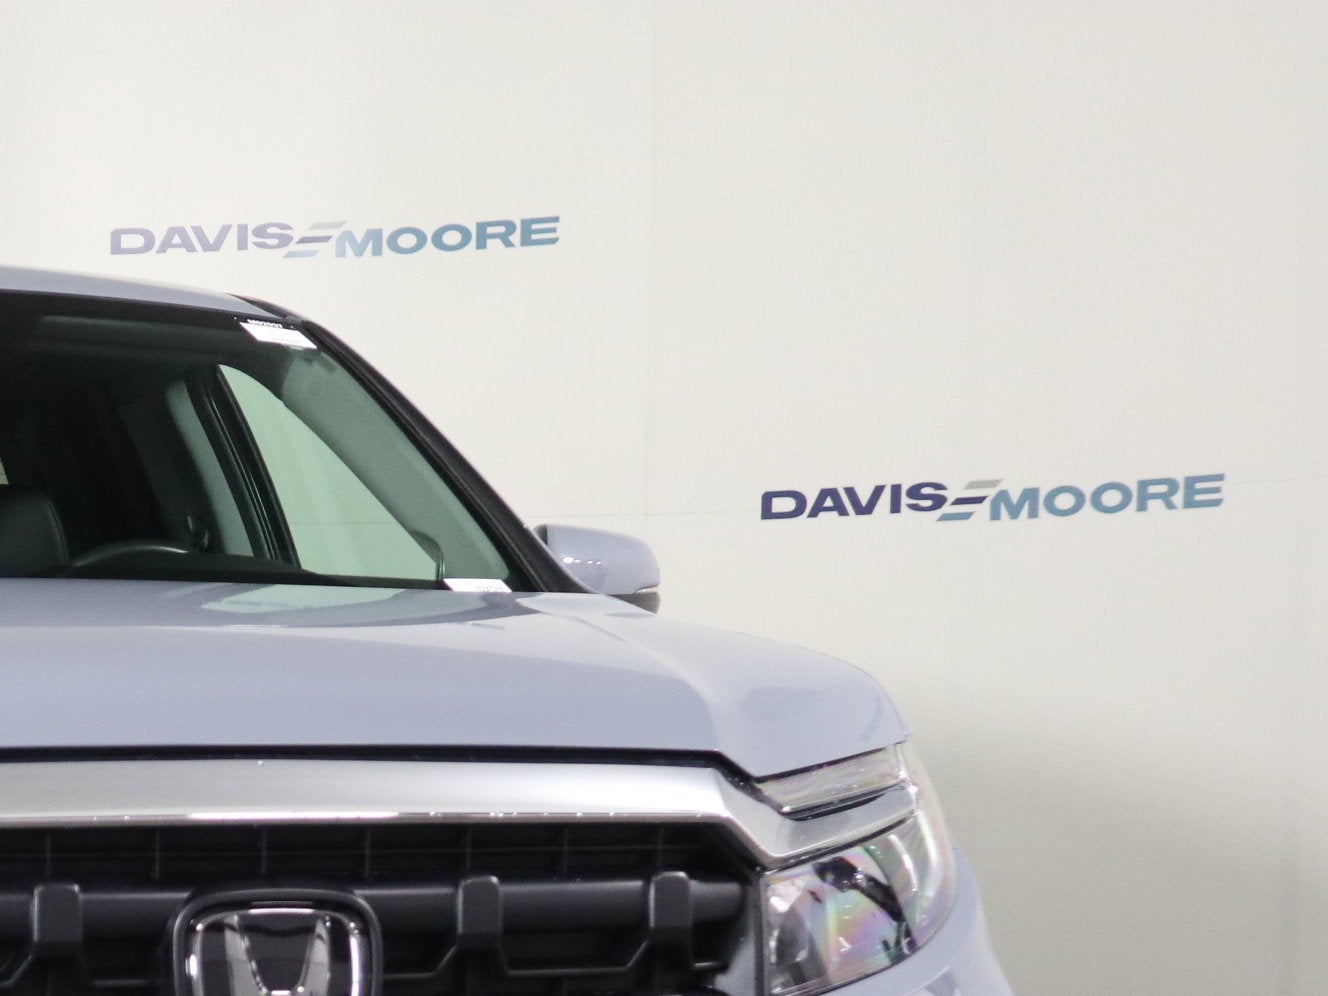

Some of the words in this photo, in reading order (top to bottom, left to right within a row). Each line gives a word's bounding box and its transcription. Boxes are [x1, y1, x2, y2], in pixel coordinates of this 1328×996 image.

[109, 221, 294, 256] DAVIS
[334, 216, 560, 258] MOORE
[760, 482, 948, 521] DAVIS
[989, 473, 1226, 521] MOORE
